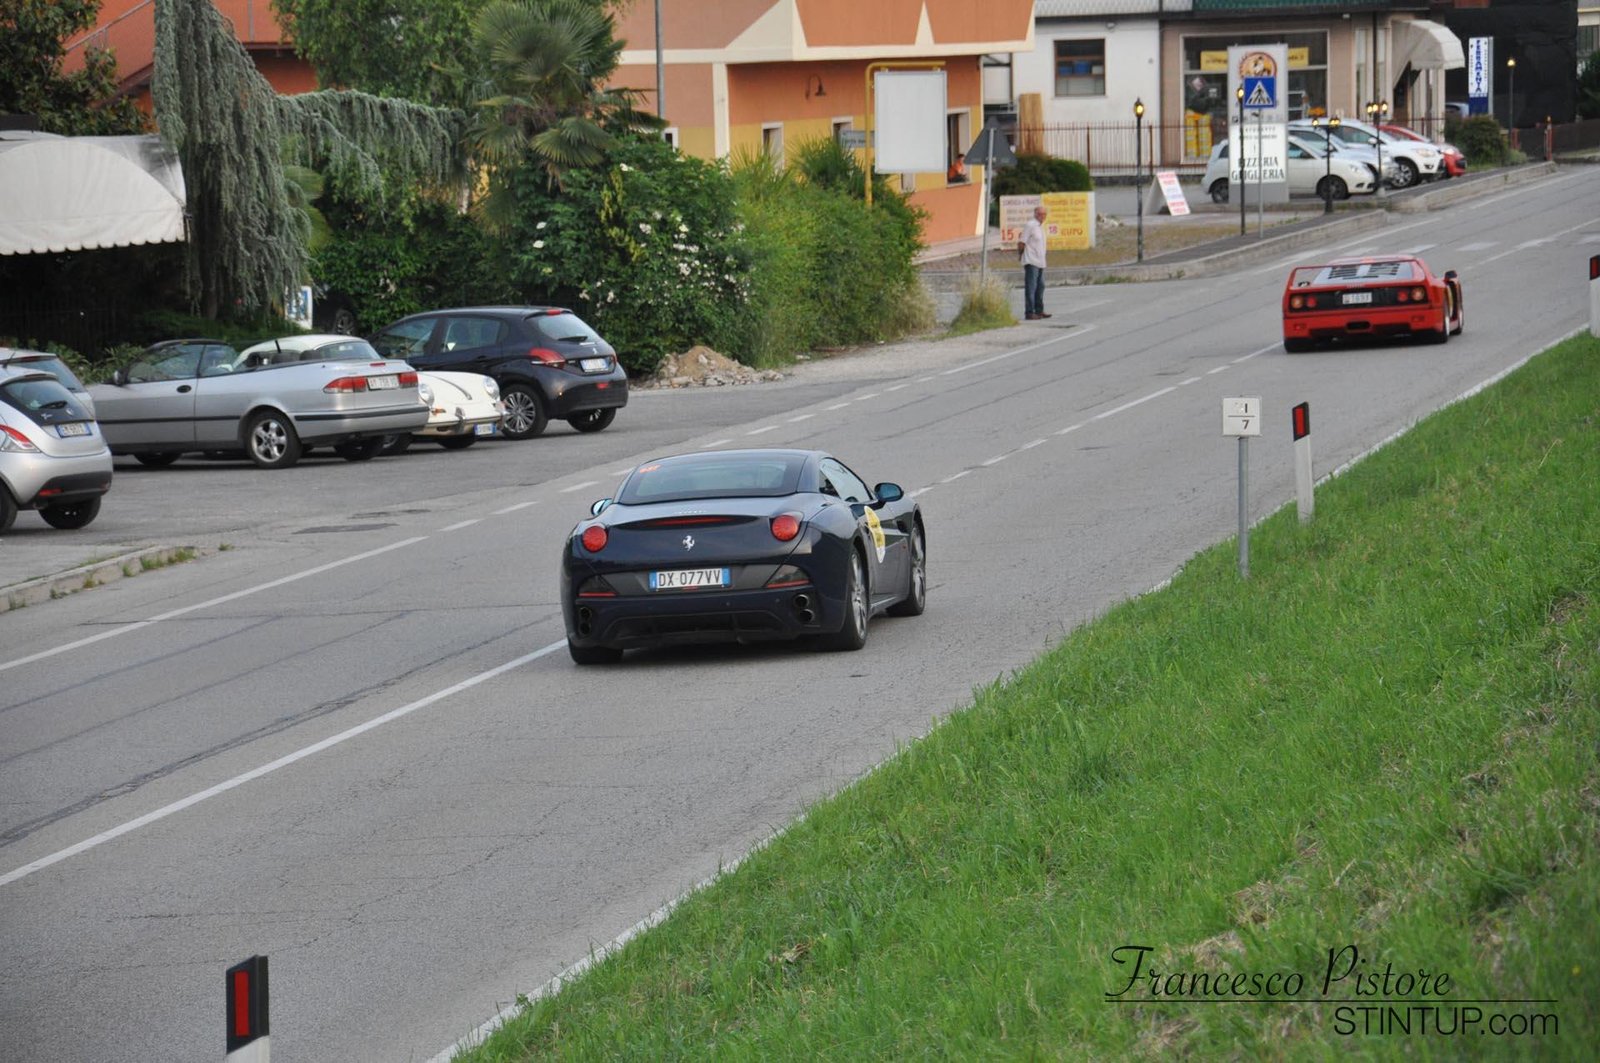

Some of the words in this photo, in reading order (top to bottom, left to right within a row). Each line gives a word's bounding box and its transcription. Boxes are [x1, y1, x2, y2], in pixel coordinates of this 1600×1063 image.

[1242, 419, 1250, 430] 7
[658, 572, 675, 587] DX
[679, 570, 721, 585] 077VV
